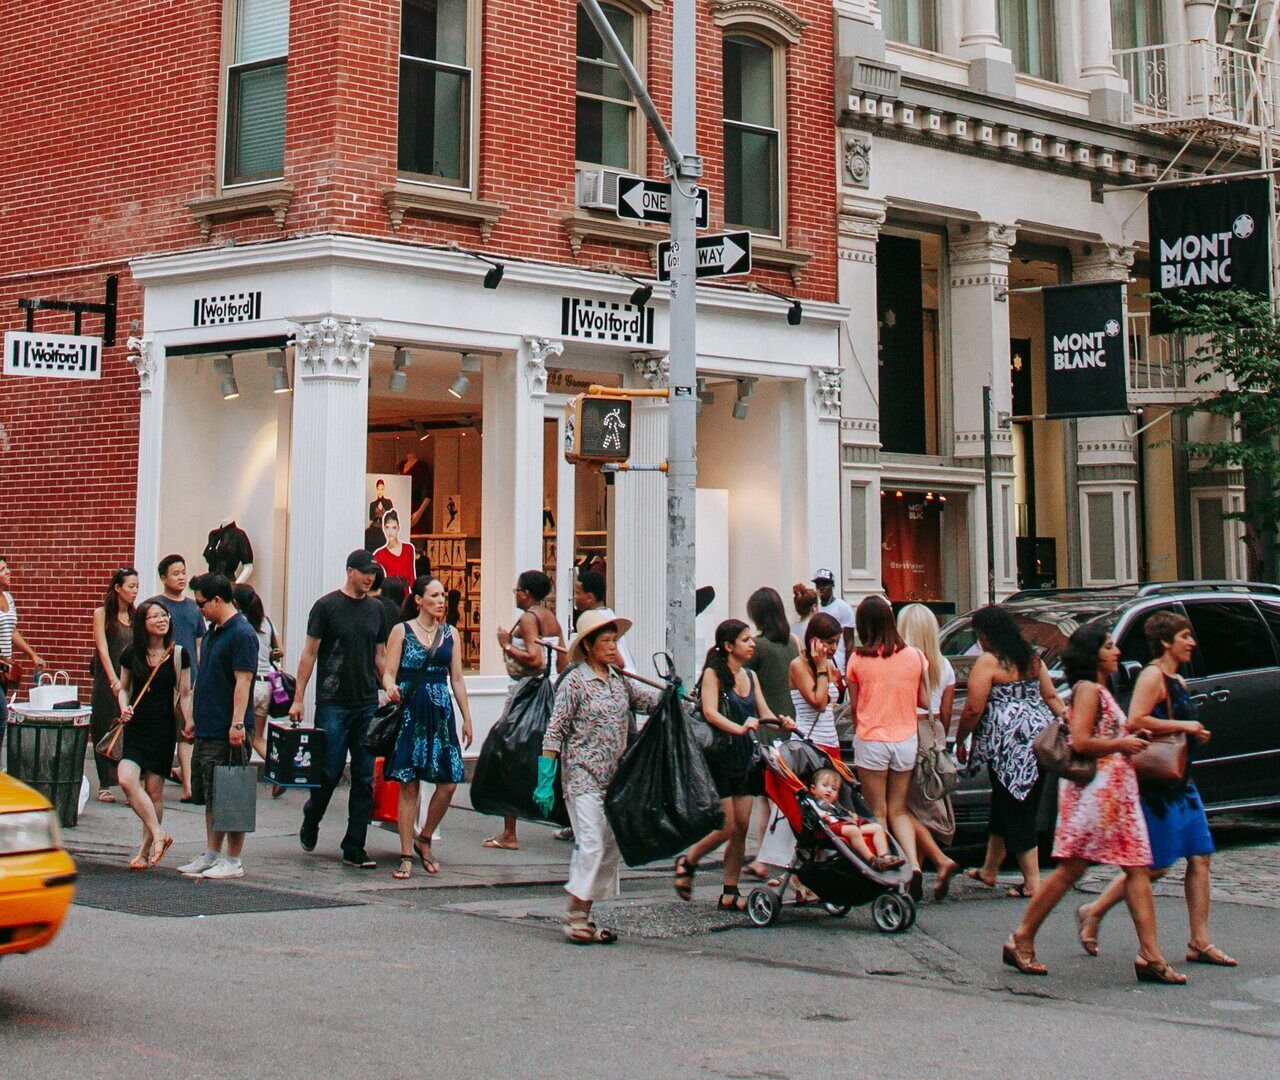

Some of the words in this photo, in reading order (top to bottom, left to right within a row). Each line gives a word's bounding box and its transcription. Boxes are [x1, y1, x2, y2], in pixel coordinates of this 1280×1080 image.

[642, 192, 667, 211] ONE
[698, 246, 725, 265] WAY
[1160, 231, 1232, 262] MONT
[1160, 257, 1232, 289] BLANC
[205, 300, 250, 318] Wolford
[578, 308, 639, 334] Wolford
[1053, 330, 1105, 352] MONT
[31, 348, 79, 364] Wolford
[1054, 350, 1107, 370] BLANC
